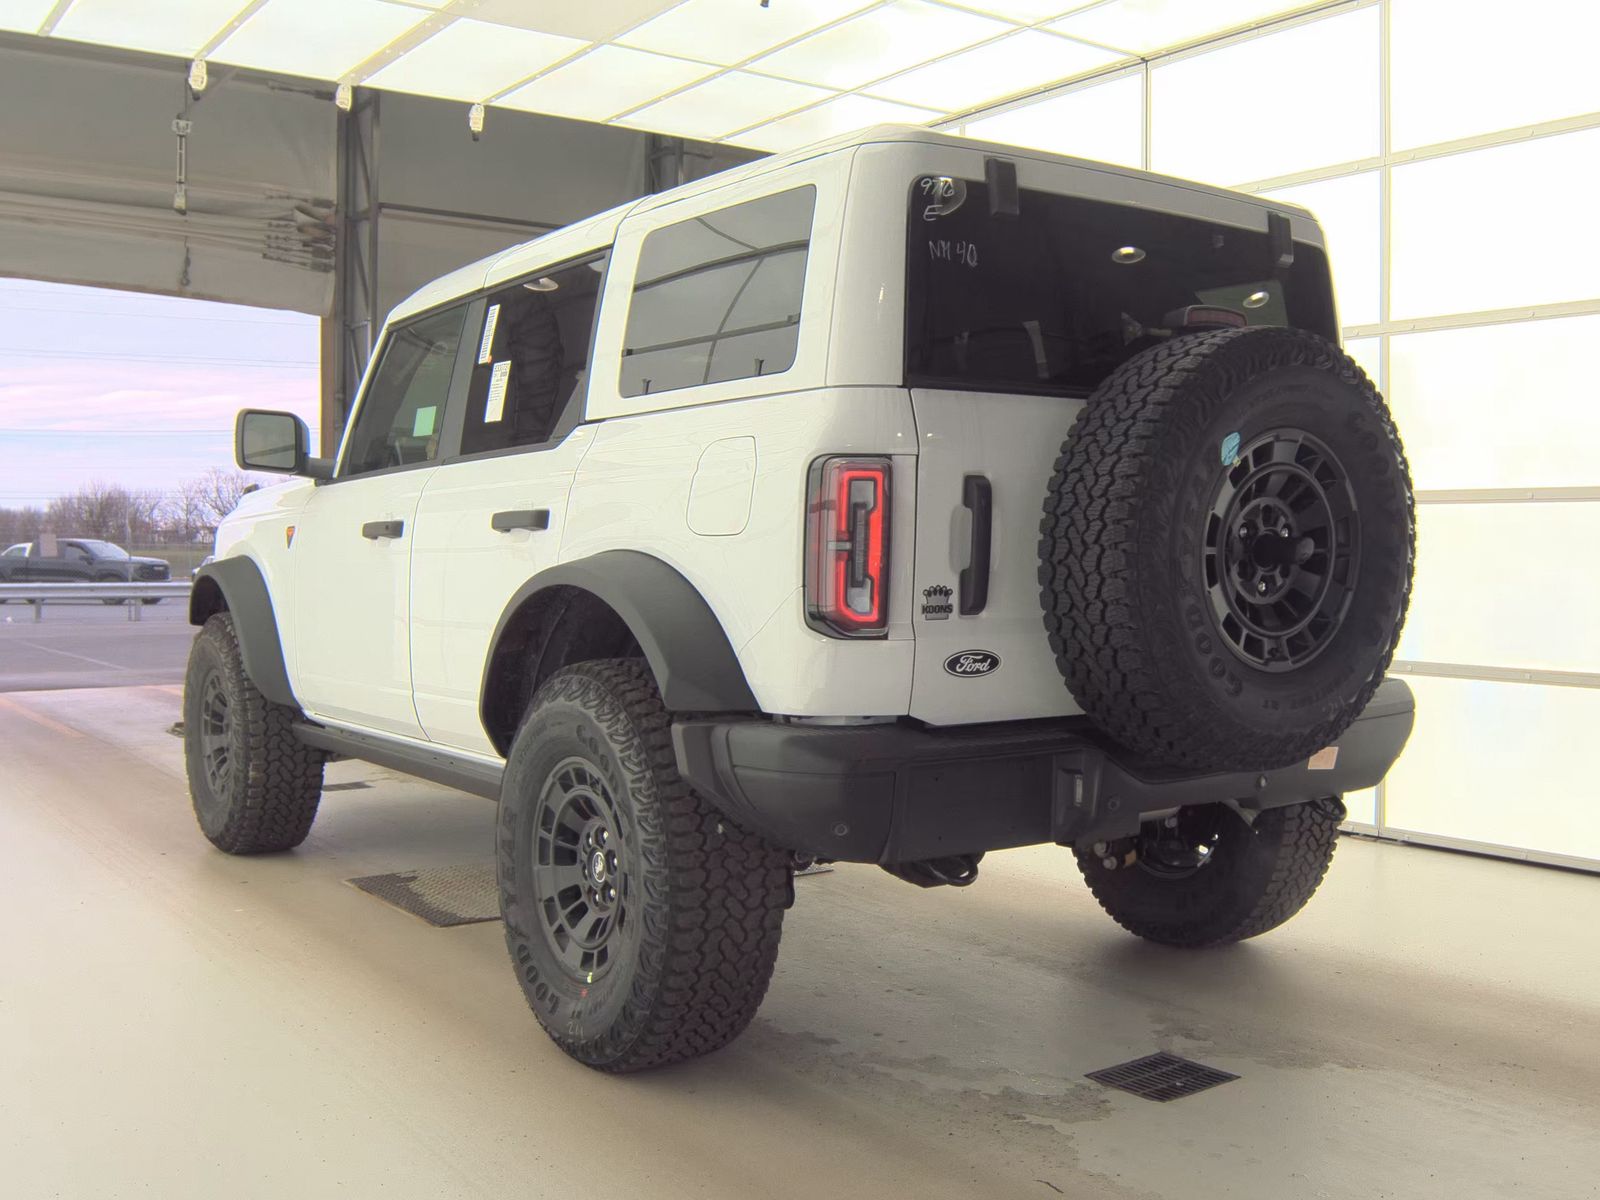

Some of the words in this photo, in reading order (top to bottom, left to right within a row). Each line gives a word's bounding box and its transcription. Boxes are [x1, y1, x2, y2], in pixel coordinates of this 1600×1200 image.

[923, 204, 943, 221] E
[922, 604, 953, 614] KOONS
[956, 655, 991, 672] Ford
